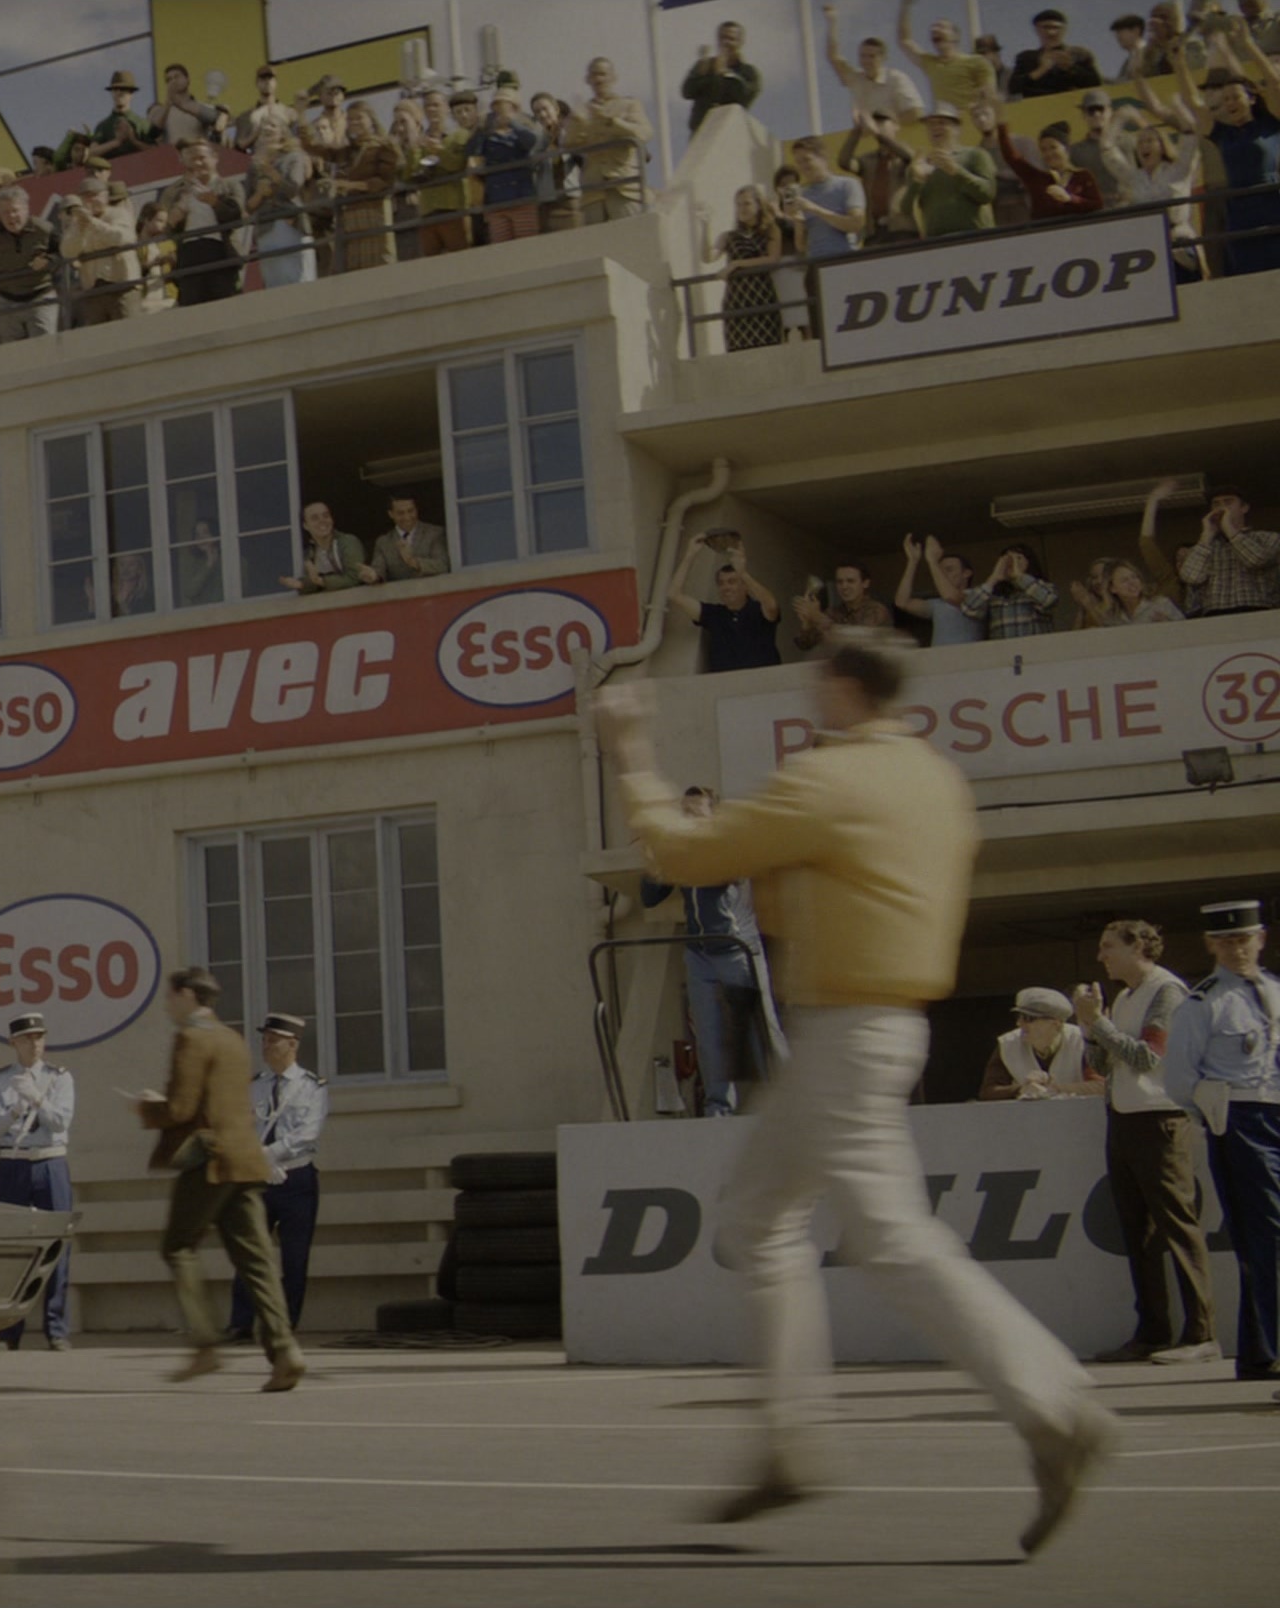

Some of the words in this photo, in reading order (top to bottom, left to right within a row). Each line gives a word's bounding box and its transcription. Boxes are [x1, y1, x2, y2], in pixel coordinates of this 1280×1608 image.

[836, 248, 1156, 333] DUNLOP
[113, 631, 396, 740] avec
[456, 620, 592, 680] Esso
[1215, 670, 1280, 727] 32
